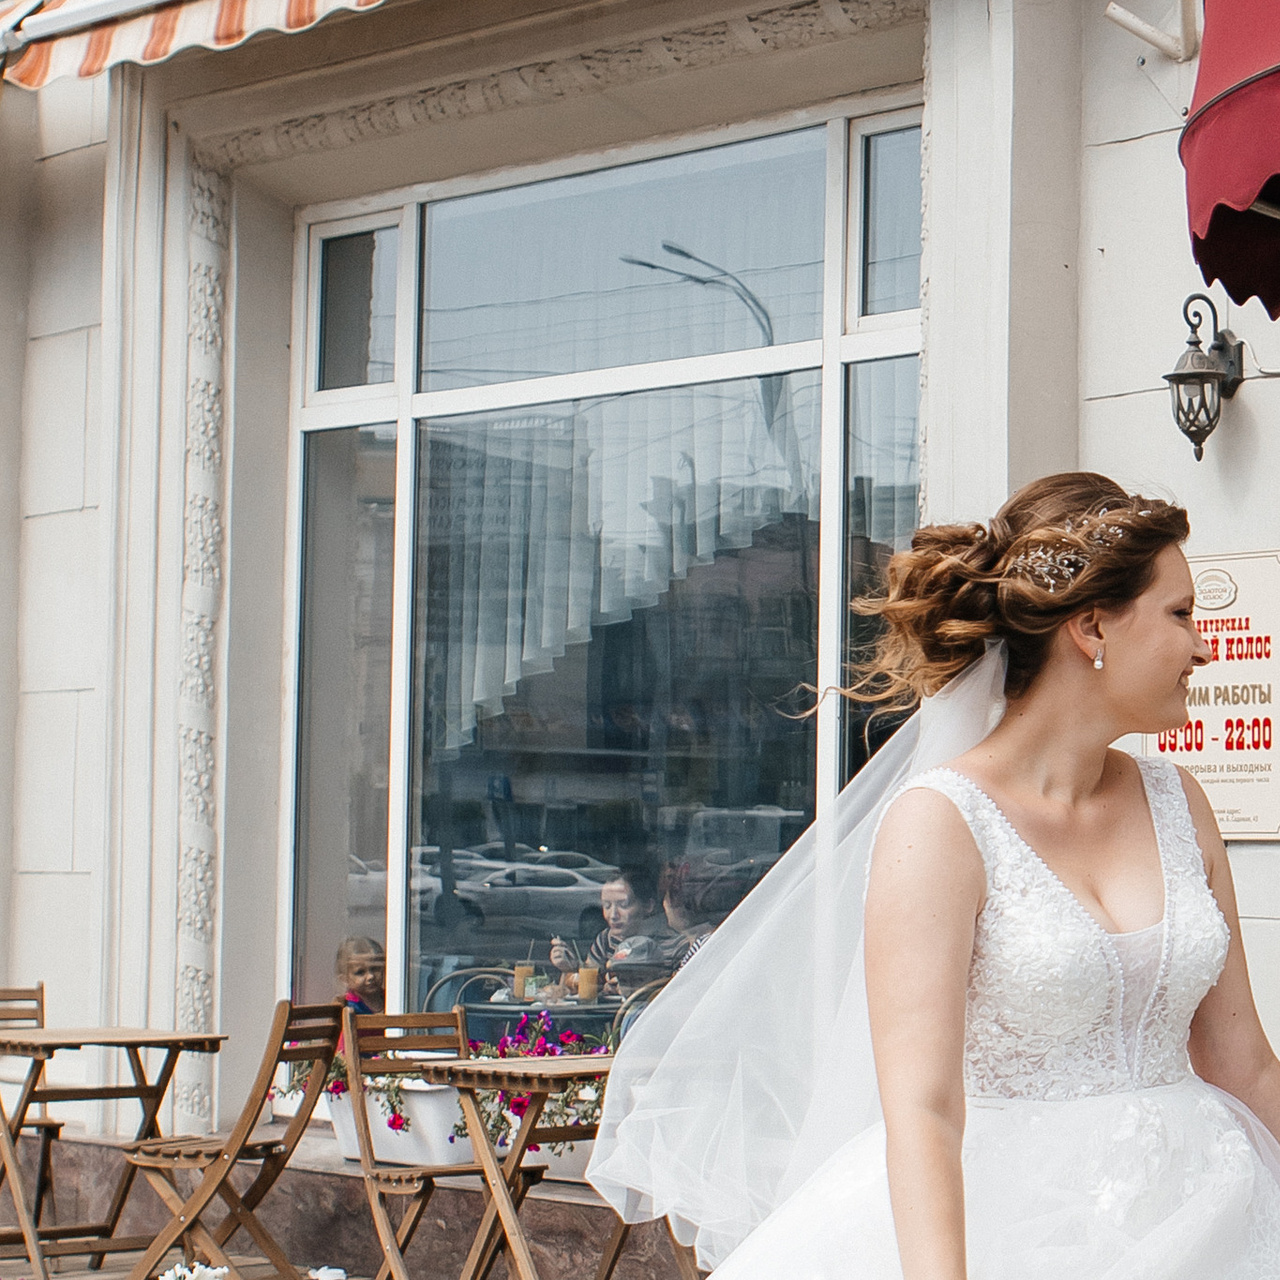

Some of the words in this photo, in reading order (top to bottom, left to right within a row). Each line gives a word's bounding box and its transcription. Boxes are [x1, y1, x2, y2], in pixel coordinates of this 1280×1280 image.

[1196, 617, 1250, 633] ДИТЕРСКАЯ
[1226, 636, 1271, 660] КОЛОС
[1214, 684, 1272, 706] РАБОТЫ
[1158, 719, 1204, 752] 09:00
[1225, 717, 1272, 750] 22:00
[1226, 763, 1272, 774] выходных
